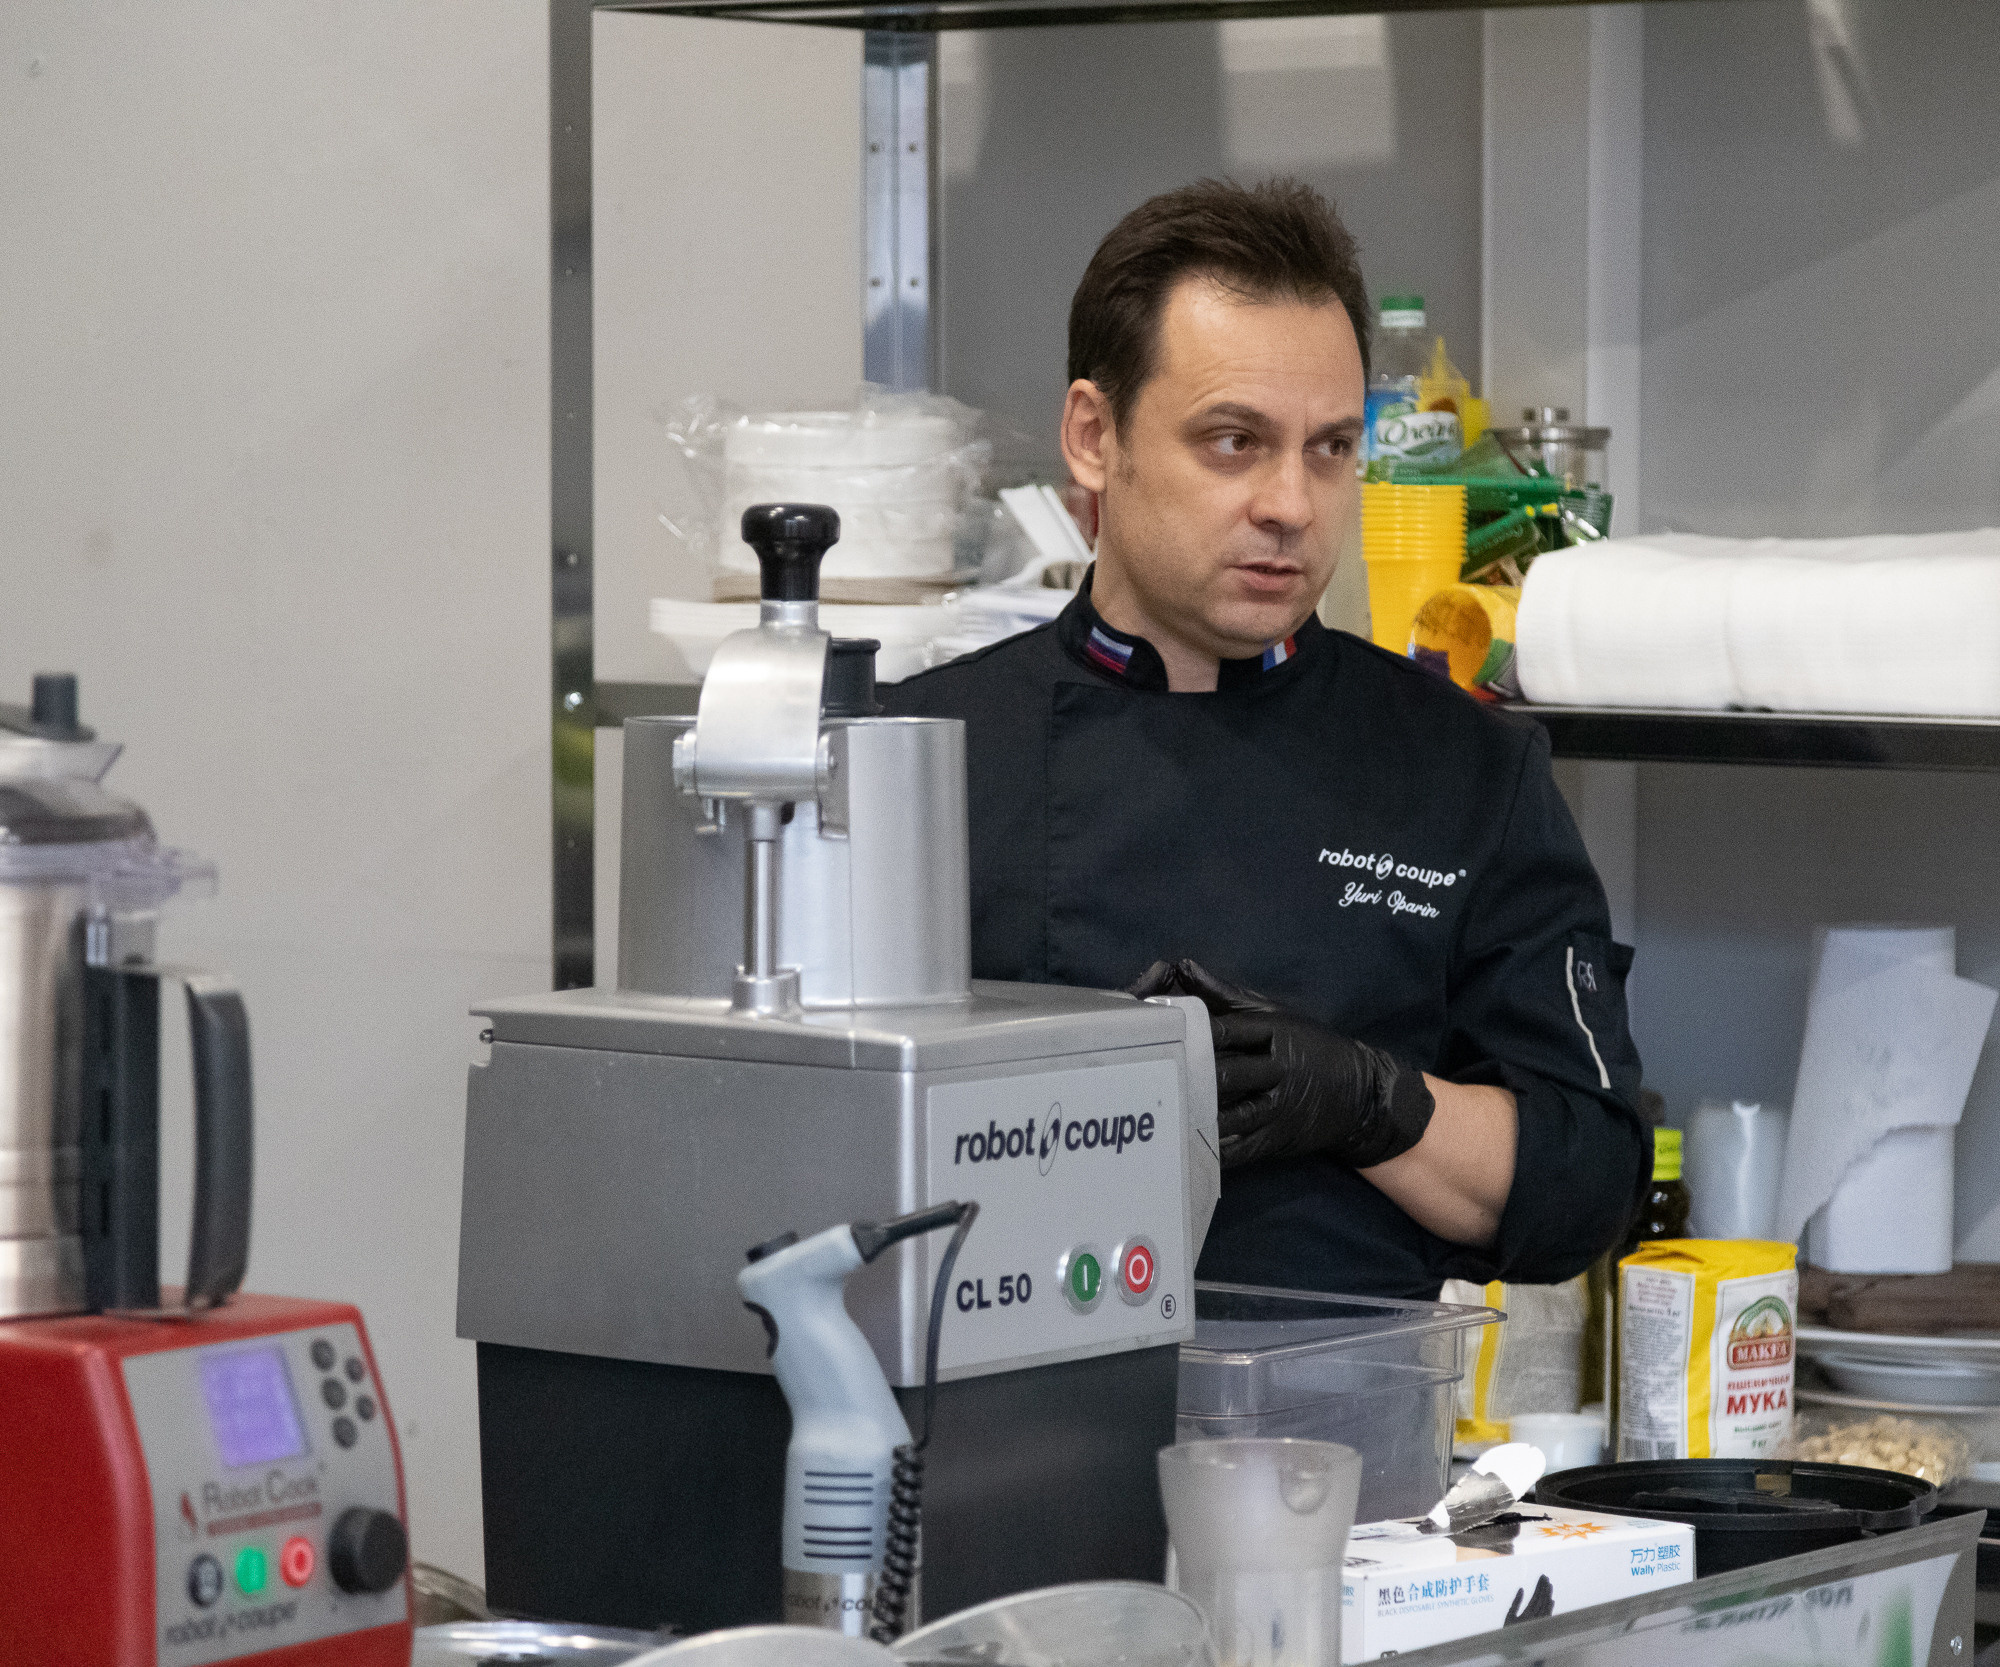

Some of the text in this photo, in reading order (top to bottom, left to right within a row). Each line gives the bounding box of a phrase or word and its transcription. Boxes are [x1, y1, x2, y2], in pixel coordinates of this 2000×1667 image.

[1318, 848, 1457, 889] robot coupe
[1338, 881, 1440, 918] Yuri Oparin
[954, 1112, 1155, 1165] robot coupe
[956, 1273, 1033, 1313] CL 50
[1726, 1388, 1788, 1414] МУКА
[1631, 1561, 1681, 1577] Wally Plastic
[1378, 1606, 1398, 1617] BLACK
[1399, 1602, 1435, 1615] DISPOSABLE
[1471, 1595, 1495, 1605] GLOVES
